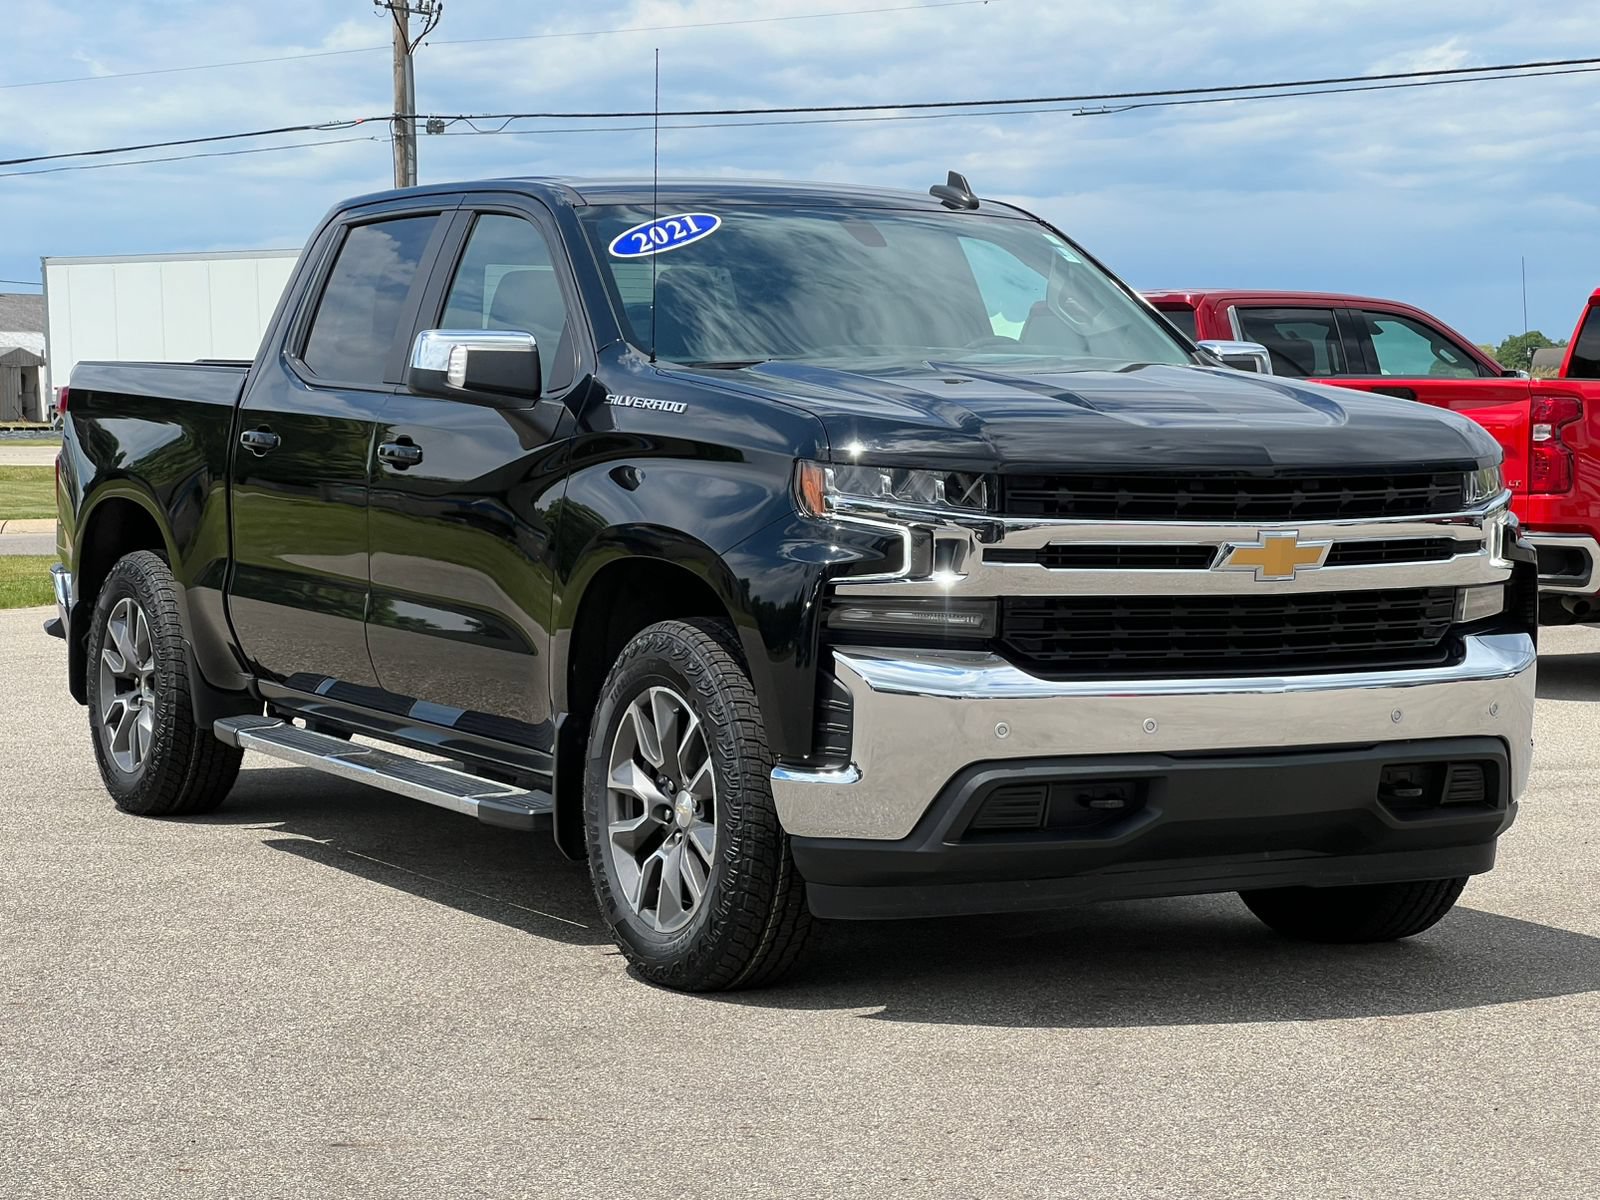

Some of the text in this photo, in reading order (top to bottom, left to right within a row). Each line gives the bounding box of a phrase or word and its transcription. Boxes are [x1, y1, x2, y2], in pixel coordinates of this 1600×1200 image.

[631, 215, 702, 252] 2021
[604, 394, 688, 414] SILVERADO
[1508, 479, 1522, 488] LT
